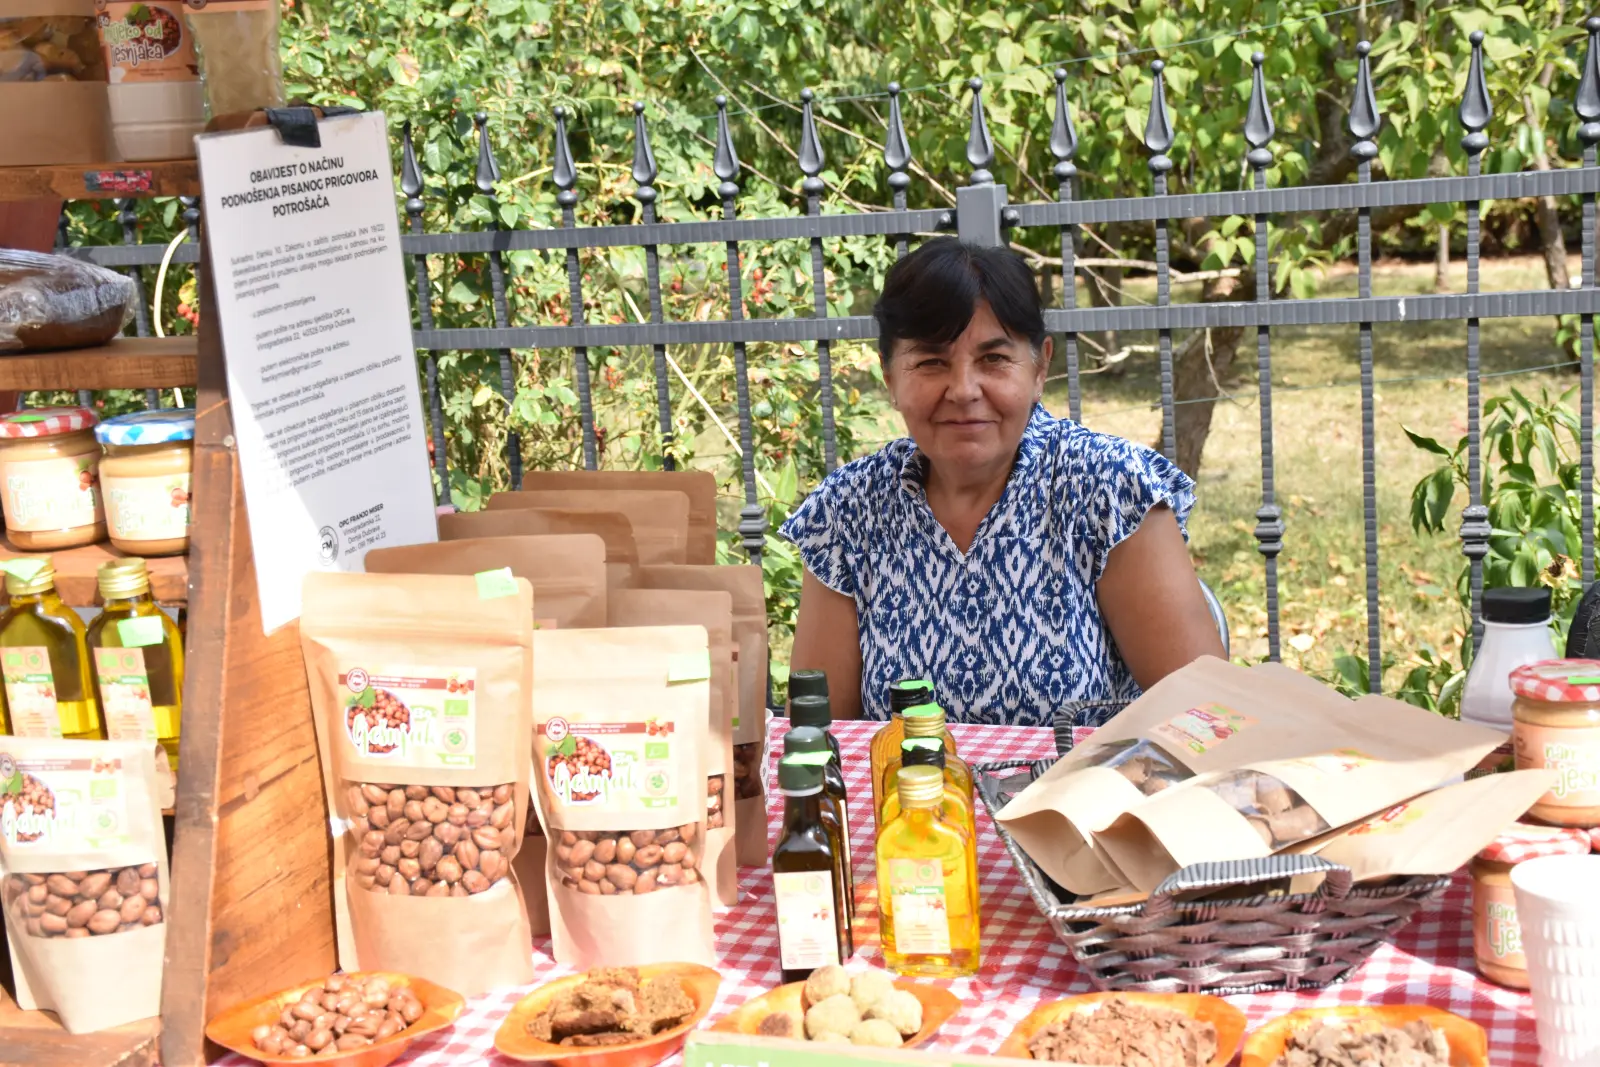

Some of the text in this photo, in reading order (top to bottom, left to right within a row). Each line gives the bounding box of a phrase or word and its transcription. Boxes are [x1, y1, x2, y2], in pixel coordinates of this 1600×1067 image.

[145, 19, 163, 39] od
[250, 156, 344, 184] OBAVIJEST O NAČINU
[221, 169, 378, 209] PODNOŠENJA PISANOG PRIGOVORA
[273, 196, 330, 217] POTROŠAČA
[339, 503, 384, 528] OPG FRANJO MISER
[322, 540, 332, 552] FM
